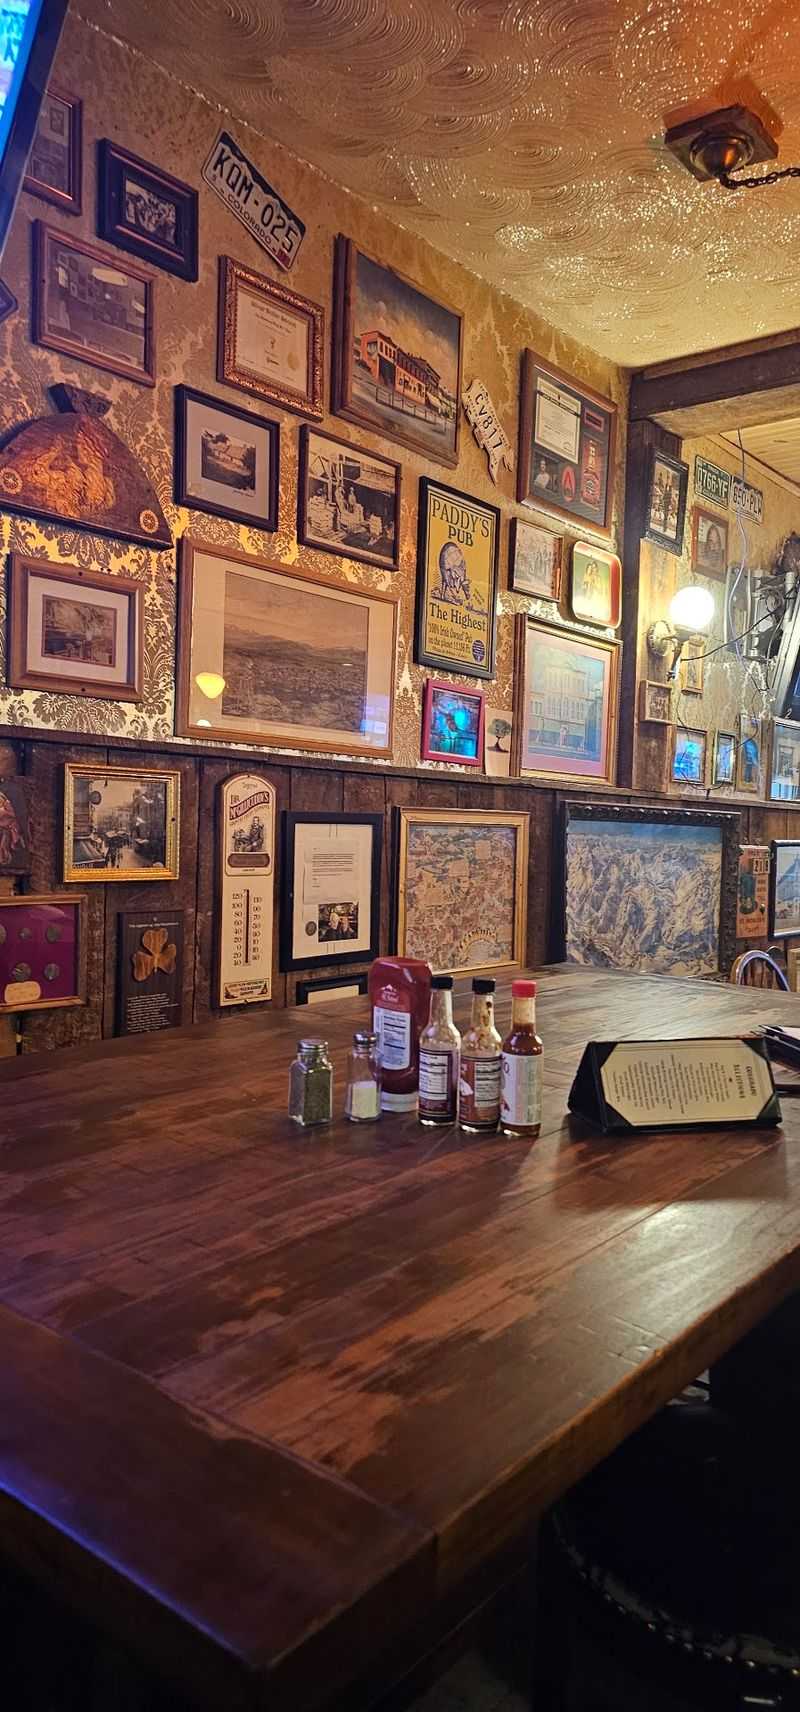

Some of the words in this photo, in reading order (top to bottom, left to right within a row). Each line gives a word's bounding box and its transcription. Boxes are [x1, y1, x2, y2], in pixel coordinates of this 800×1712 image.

[227, 193, 273, 244] COLORADO
[475, 393, 503, 449] CV817
[431, 498, 490, 539] PADDY'S
[448, 524, 474, 547] PUB
[429, 602, 448, 621] The
[450, 609, 486, 632] Highest
